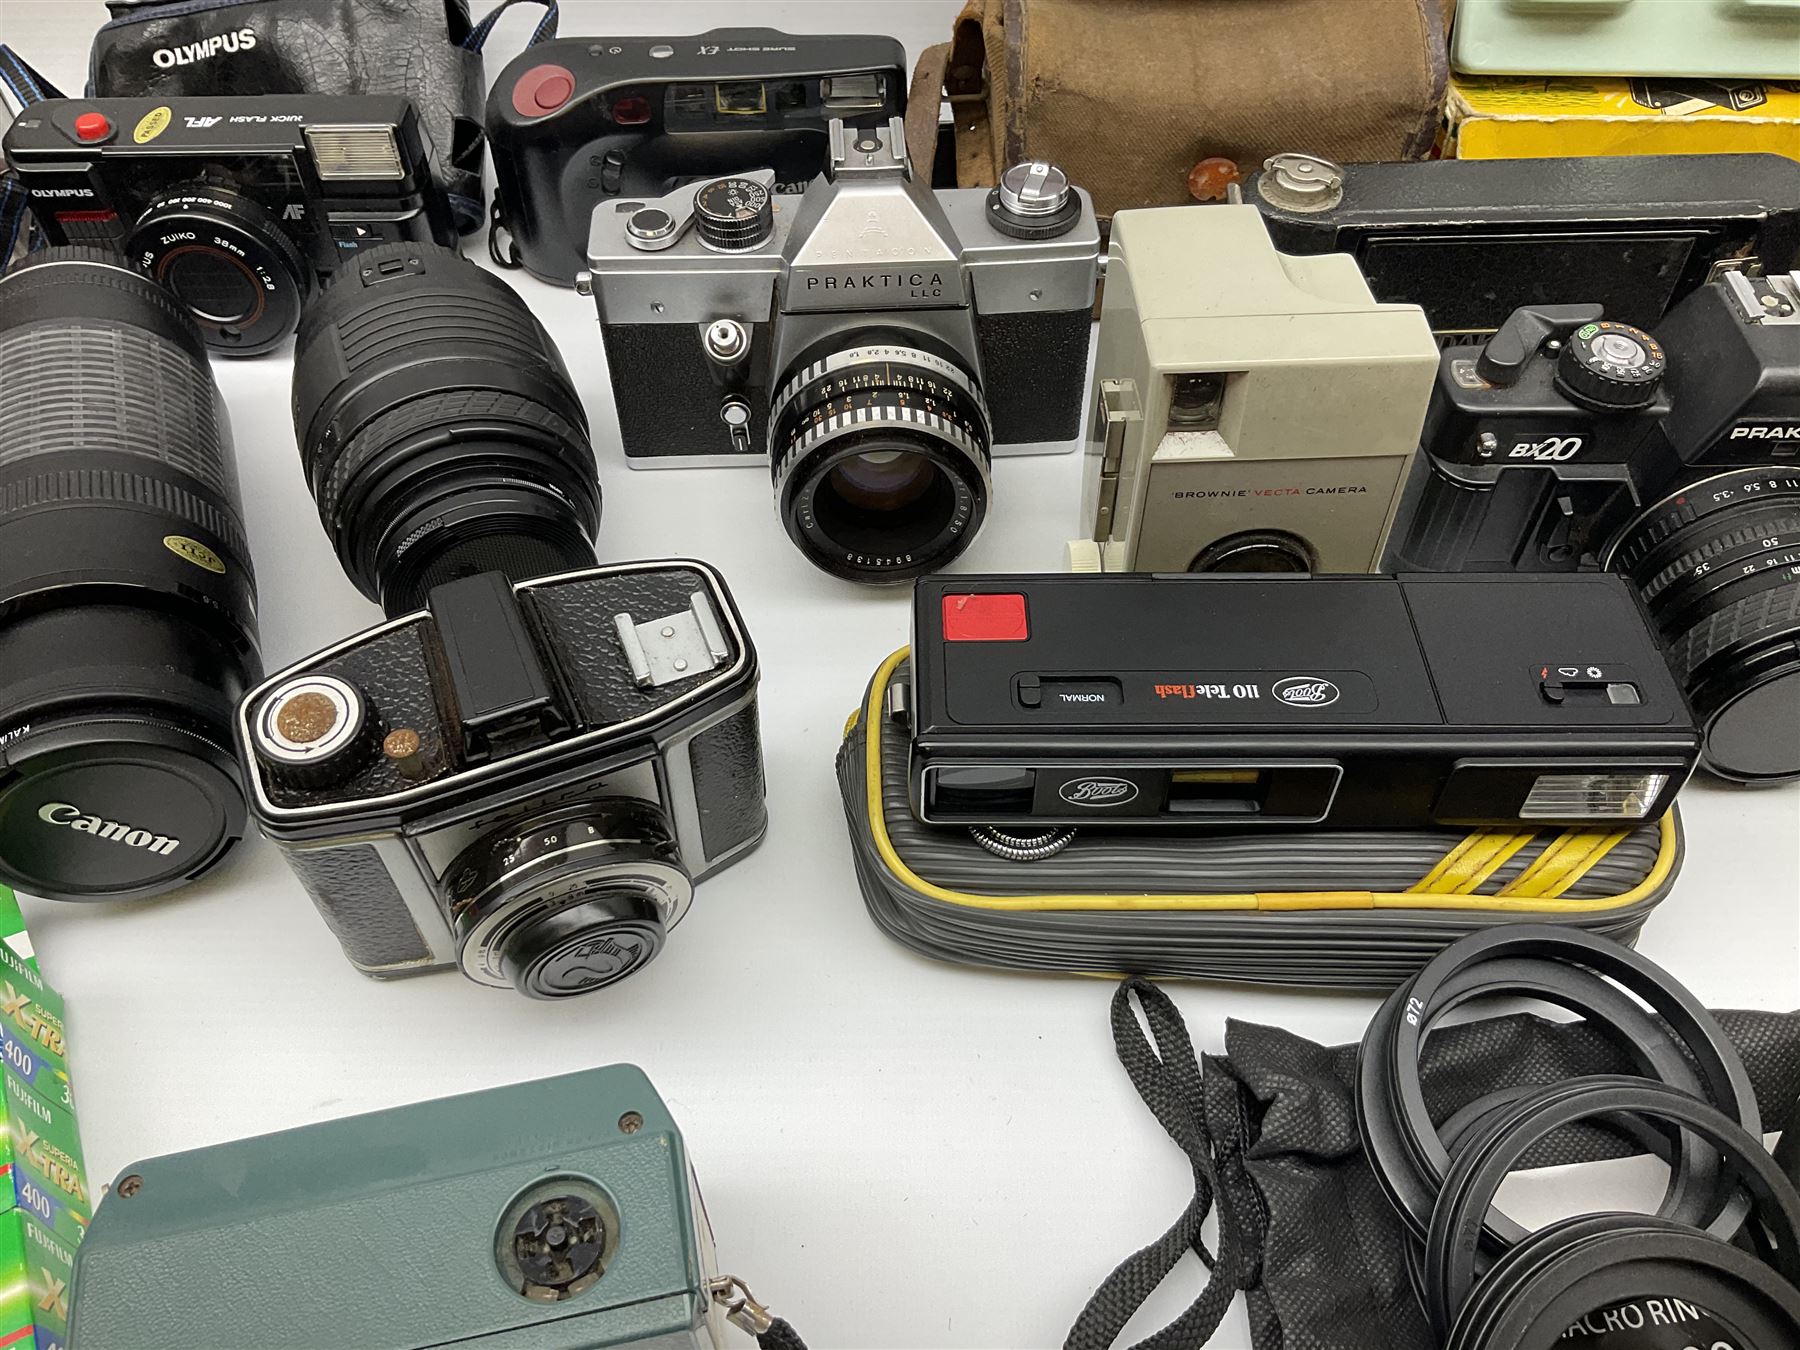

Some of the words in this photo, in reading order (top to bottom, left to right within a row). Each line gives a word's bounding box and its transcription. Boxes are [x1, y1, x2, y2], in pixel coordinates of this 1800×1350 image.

[153, 28, 257, 68] OLYMPUS
[697, 46, 720, 55] EX
[141, 111, 164, 138] PASSED
[184, 116, 223, 128] AFL
[229, 115, 267, 123] FLASH
[32, 188, 94, 198] OLYMPUS
[213, 200, 232, 210] 1000
[282, 204, 305, 220] AF
[160, 231, 196, 245] ZUIKO
[213, 236, 246, 257] 38mm
[806, 273, 943, 290] PRAKTICA
[910, 288, 942, 298] LLC
[923, 355, 931, 363] 11
[945, 364, 955, 374] 22
[838, 378, 848, 387] 16
[852, 375, 861, 384] 11
[907, 375, 914, 383] 8
[915, 376, 925, 385] 11
[927, 380, 937, 389] 16
[821, 384, 832, 395] 22
[942, 387, 953, 397] 22
[846, 395, 852, 403] 3
[812, 408, 821, 418] 10
[1508, 437, 1582, 461] BX20
[1254, 487, 1300, 497] VECTA
[1305, 486, 1367, 496] CAMERA
[1743, 482, 1761, 493] 5.6
[1768, 480, 1778, 489] 8
[1785, 479, 1799, 488] 11
[1762, 537, 1779, 548] 50
[1766, 558, 1779, 566] 16
[1784, 554, 1796, 562] 11
[1695, 562, 1711, 575] 35
[1742, 564, 1756, 574] 22
[1154, 683, 1229, 699] Teleflash
[1233, 684, 1259, 698] 110
[1281, 681, 1331, 703] Boots
[1059, 693, 1105, 702] NORMAL
[1068, 781, 1129, 801] Boots
[38, 803, 180, 856] Canon
[503, 854, 515, 867] 25
[543, 835, 558, 846] 50
[588, 826, 595, 834] B
[4, 1039, 32, 1076] 400
[7, 1074, 52, 1125] FUJIFILM
[15, 1116, 85, 1203] X-TRA
[42, 1138, 79, 1171] SUPERIA
[21, 1182, 51, 1220] 400
[26, 1222, 74, 1267] FUJIFILM
[1561, 1303, 1645, 1338] ACRO
[1646, 1297, 1711, 1326] RIN
